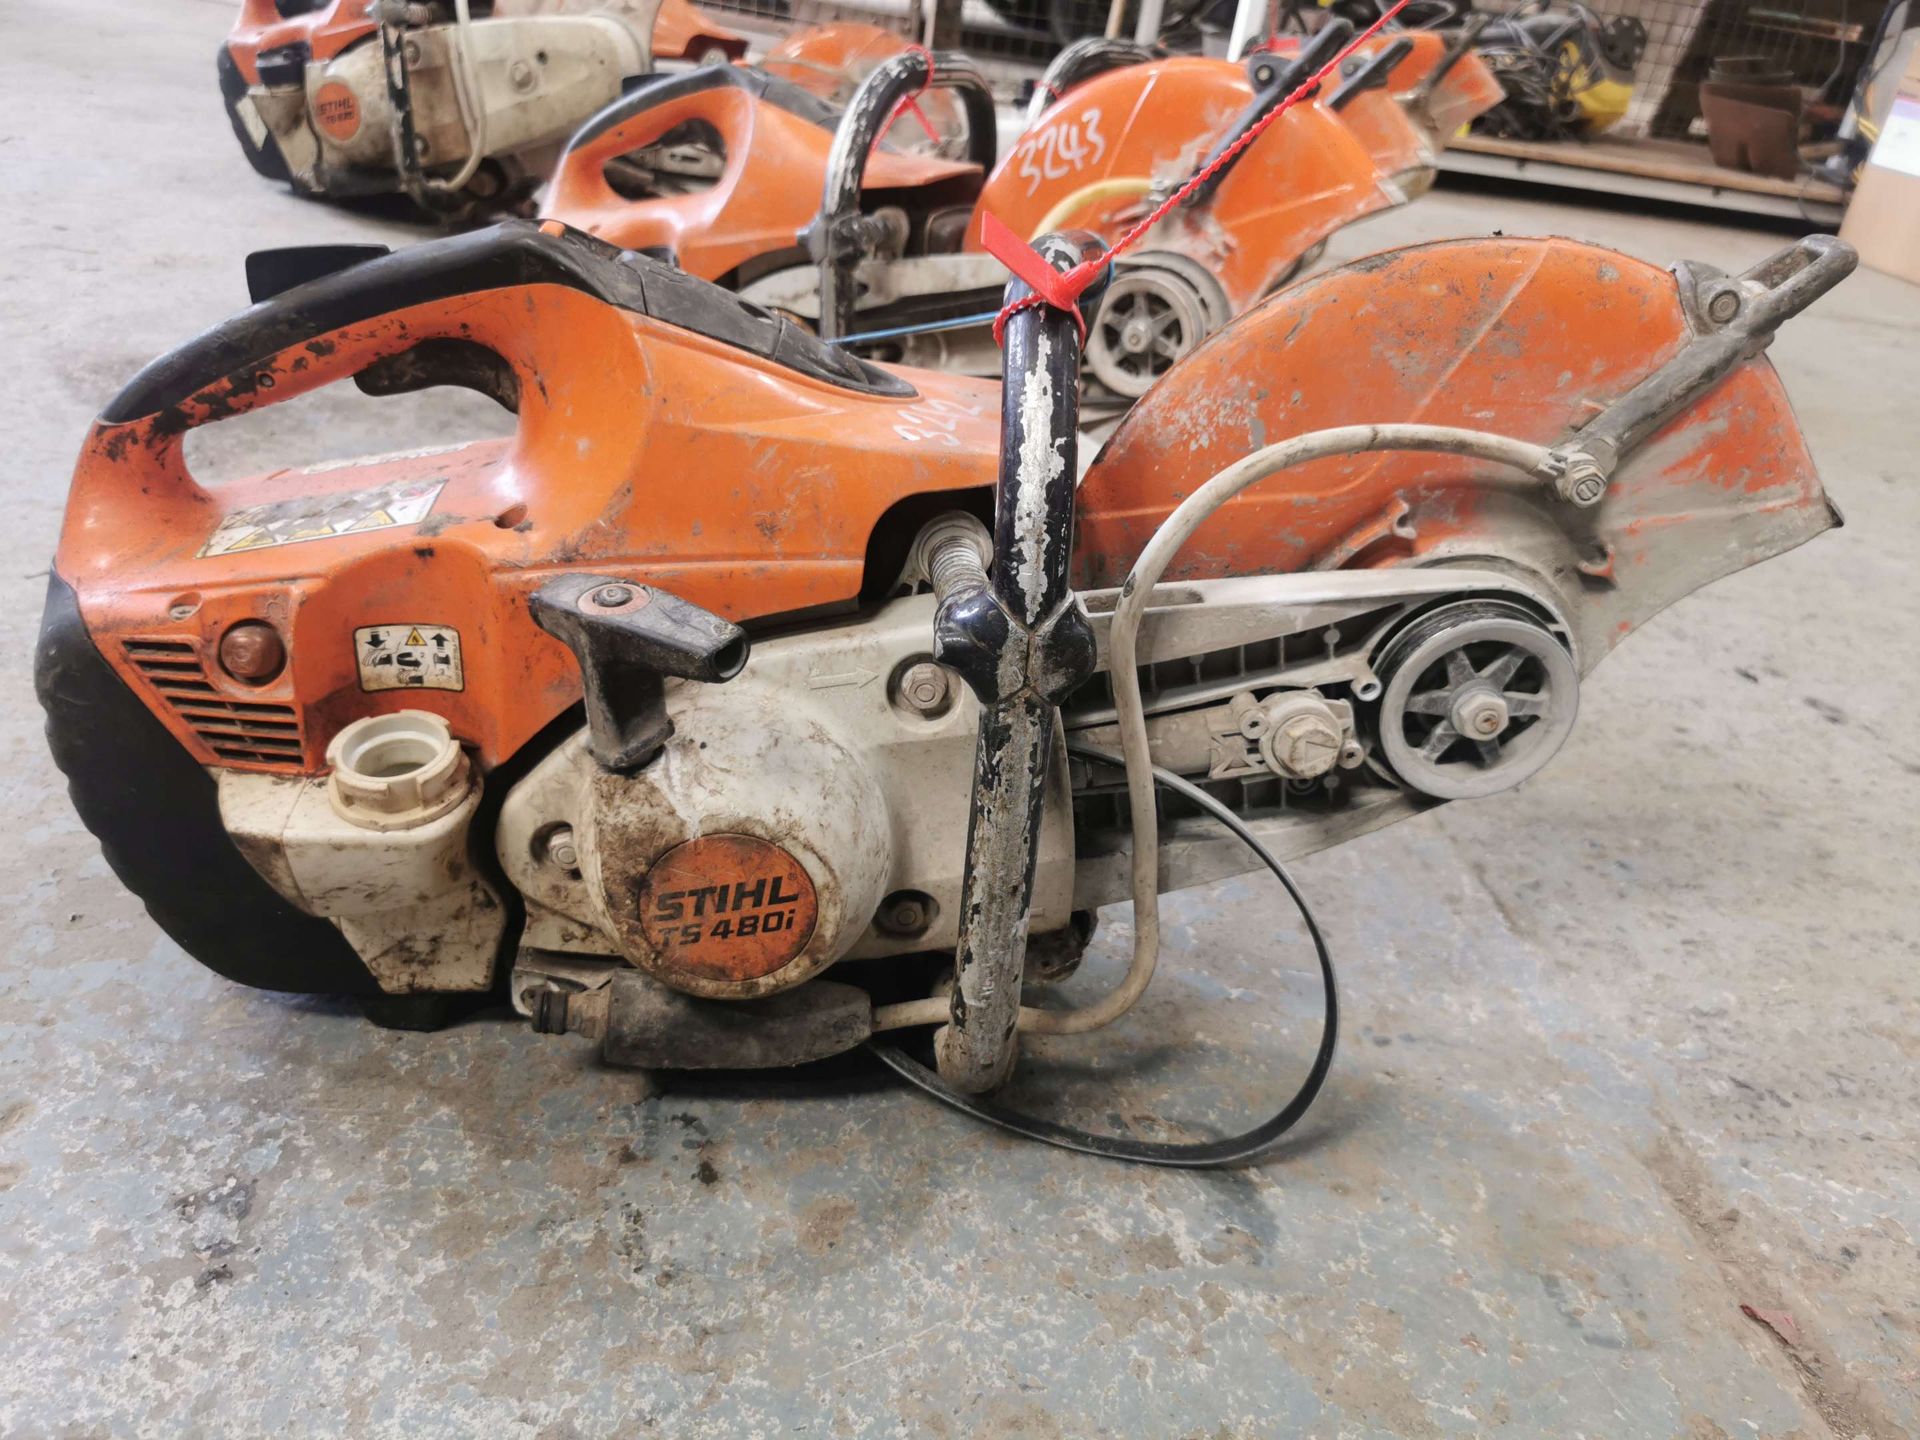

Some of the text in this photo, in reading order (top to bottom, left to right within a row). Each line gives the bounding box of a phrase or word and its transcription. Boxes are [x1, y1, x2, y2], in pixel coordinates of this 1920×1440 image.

[1017, 108, 1106, 198] 3243
[655, 876, 799, 922] STIHL
[657, 908, 796, 947] TS 480i
